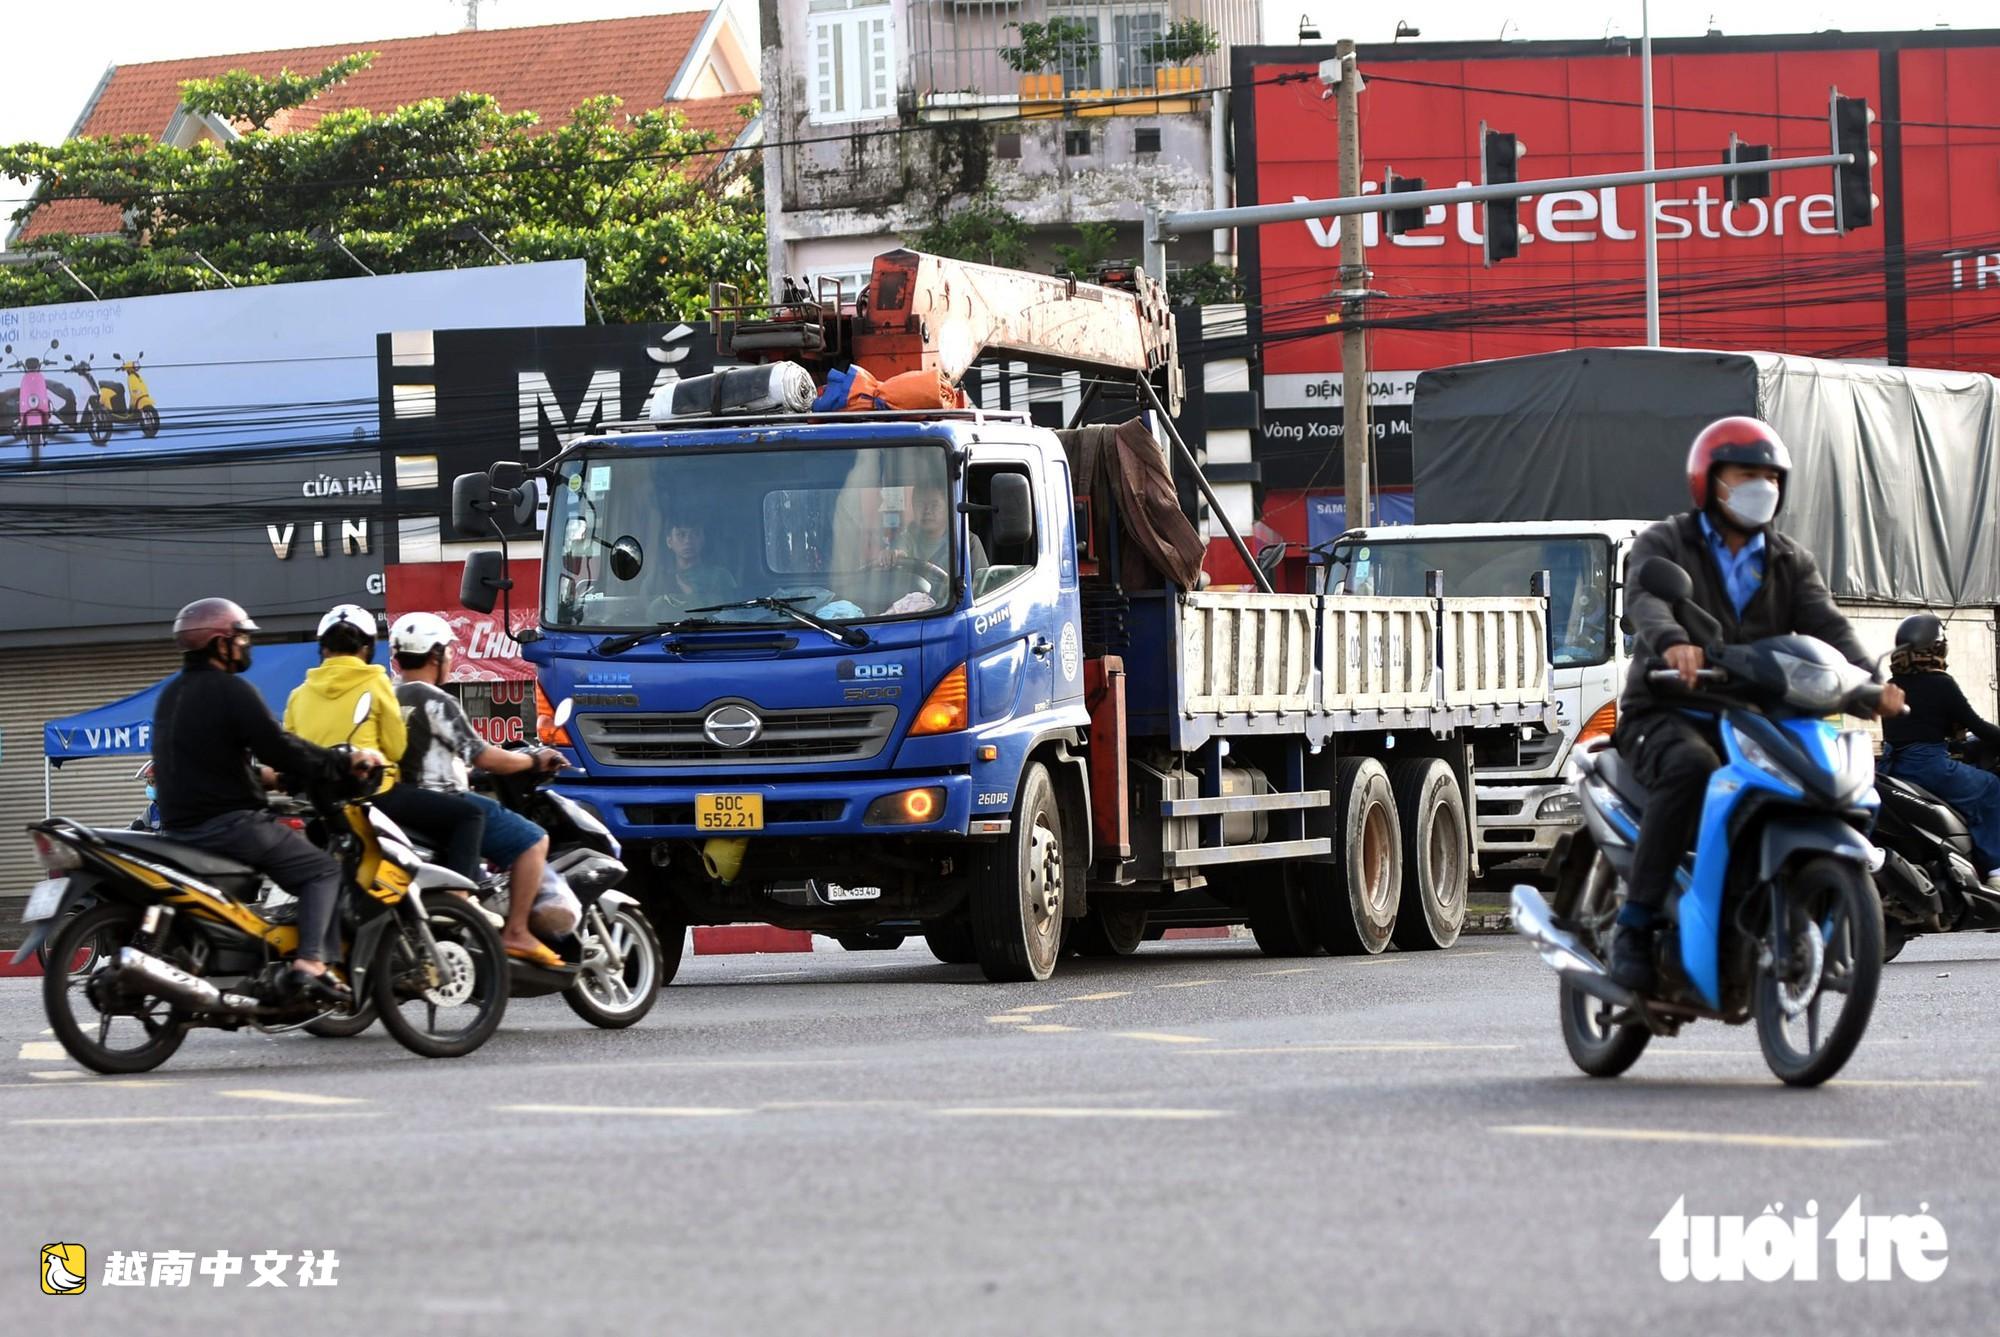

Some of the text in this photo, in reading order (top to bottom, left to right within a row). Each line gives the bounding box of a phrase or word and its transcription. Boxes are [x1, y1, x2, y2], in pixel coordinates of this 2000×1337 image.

[1305, 380, 1342, 400] ĐIỆN
[1264, 421, 1304, 441] Vòng
[1308, 421, 1344, 437] Xoay
[302, 473, 344, 497] CỬA
[266, 517, 369, 560] VIN
[855, 663, 904, 679] QDR
[844, 685, 902, 700] 500
[715, 795, 743, 811] 60C
[978, 792, 1009, 805] 260PS
[703, 812, 755, 828] 552.21
